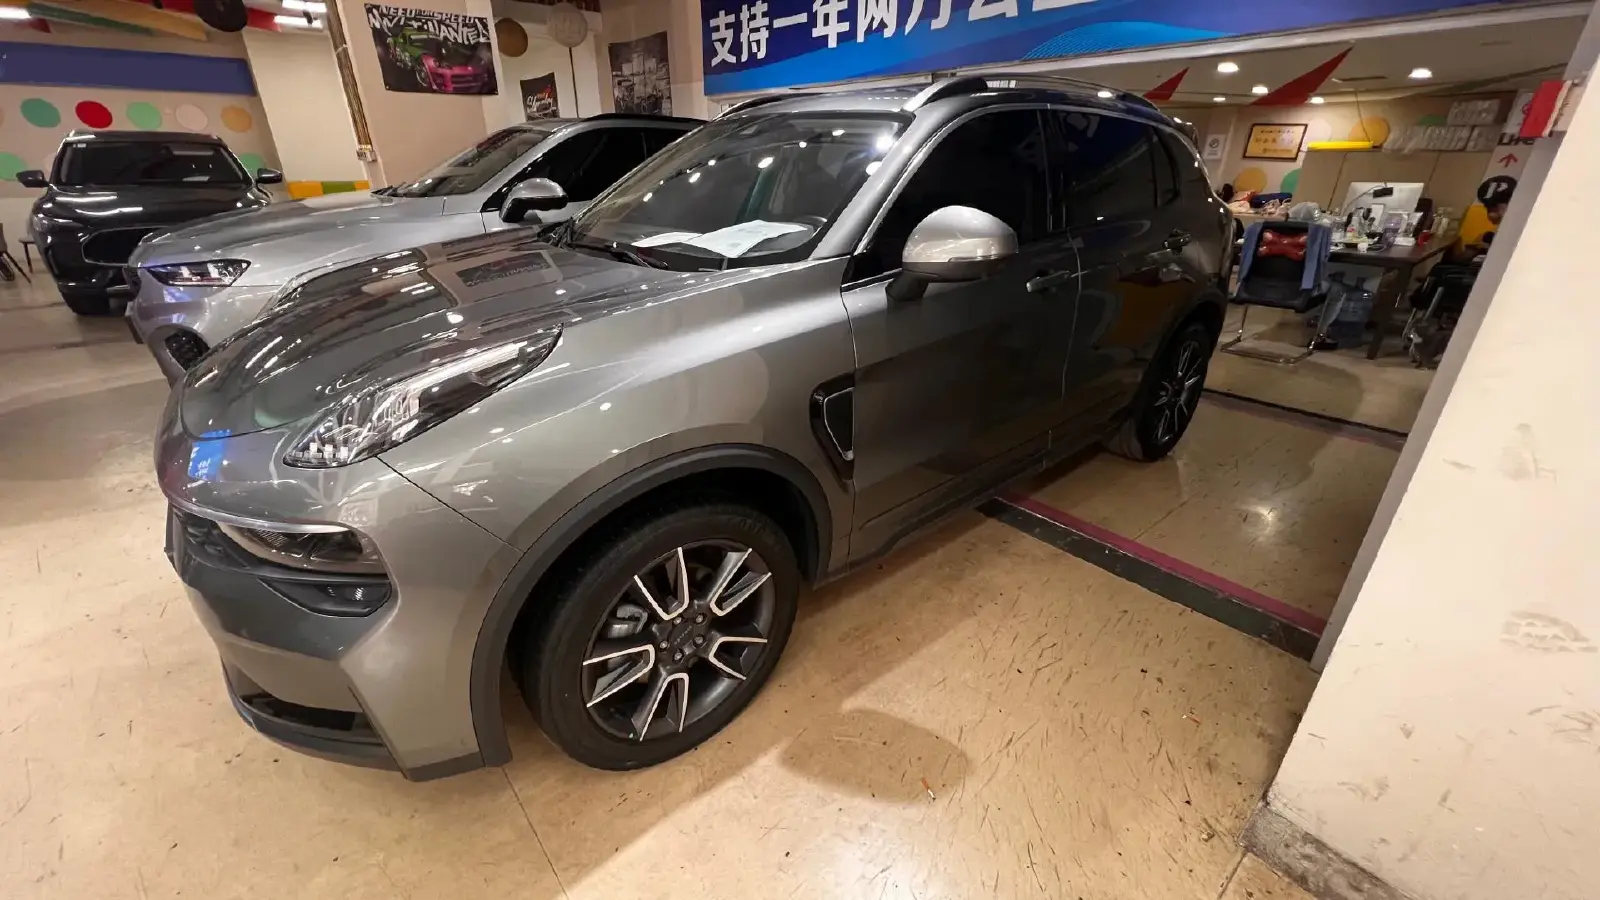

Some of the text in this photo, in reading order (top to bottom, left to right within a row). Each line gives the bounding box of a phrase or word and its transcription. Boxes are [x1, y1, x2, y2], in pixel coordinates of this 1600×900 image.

[380, 6, 416, 17] NEED
[434, 11, 474, 24] SPEED
[709, 0, 1105, 67] 支持一年两
